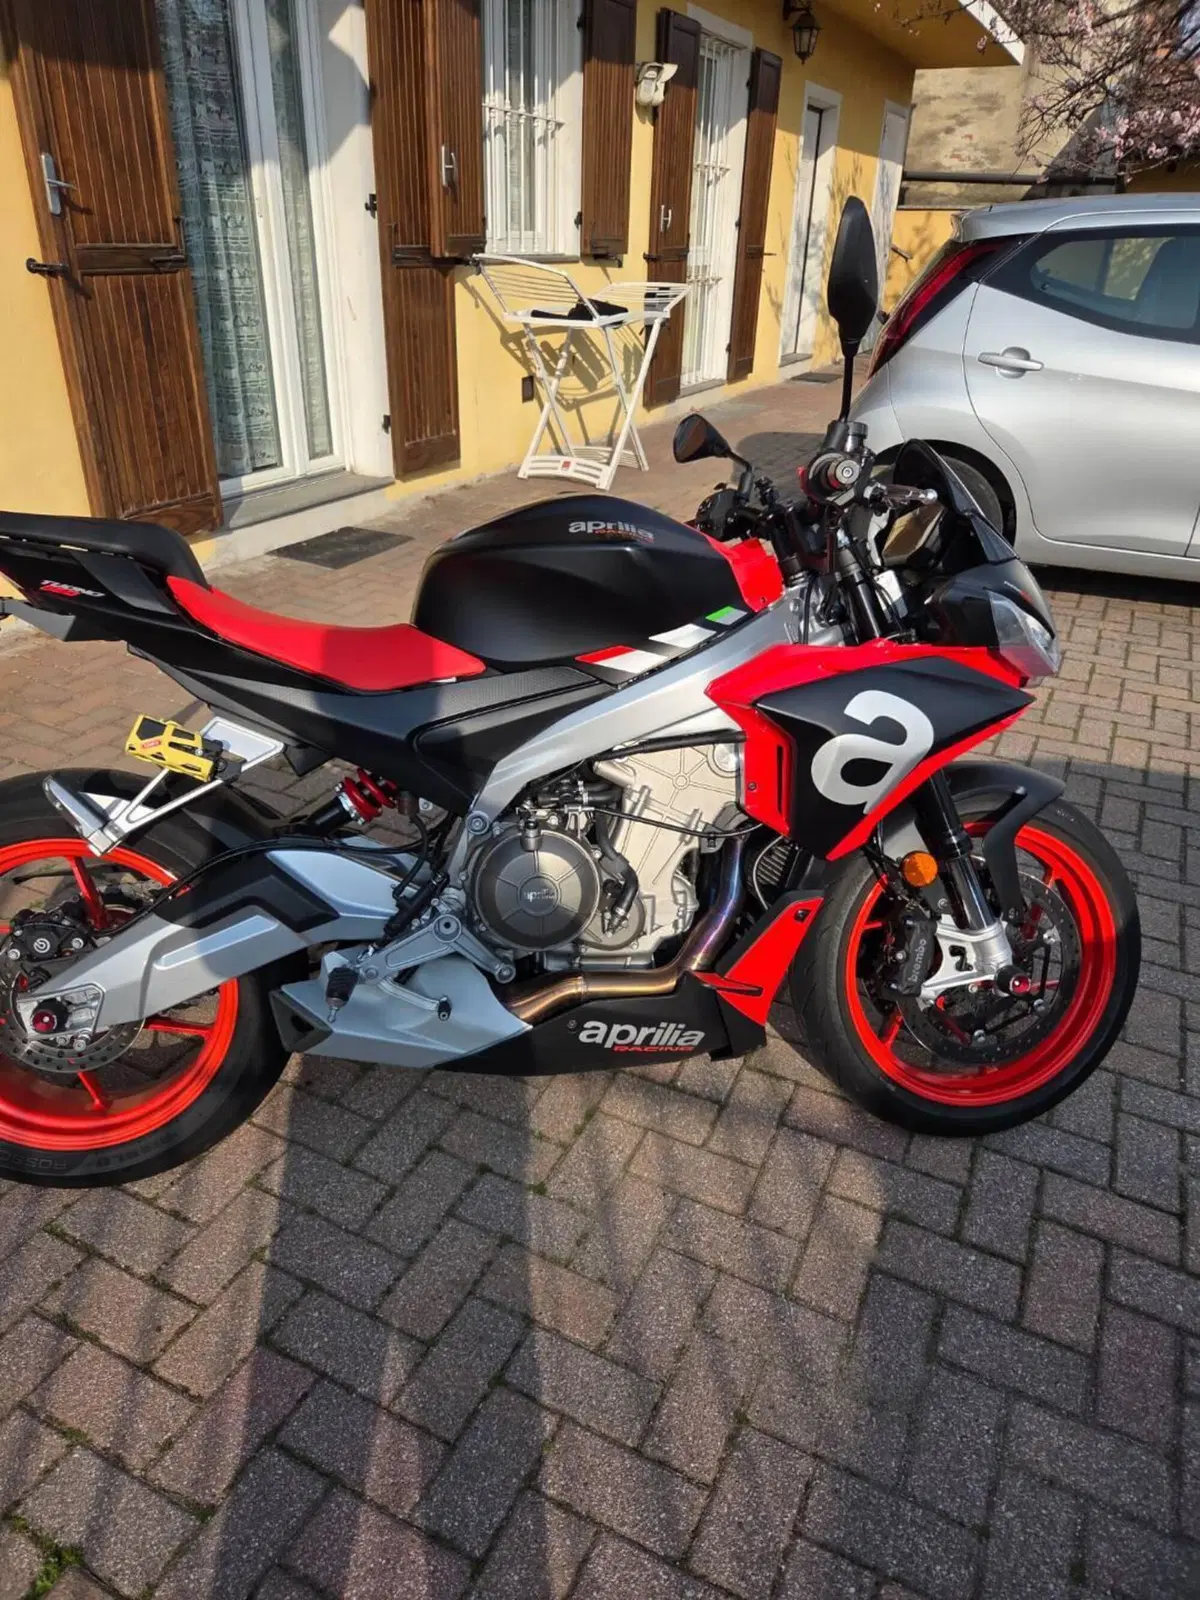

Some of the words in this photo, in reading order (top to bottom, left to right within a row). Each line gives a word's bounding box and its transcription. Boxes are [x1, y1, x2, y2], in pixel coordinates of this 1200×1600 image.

[568, 520, 654, 539] aprilia
[811, 690, 934, 815] a
[907, 938, 927, 982] brembo
[578, 1020, 706, 1049] aprilia
[613, 1045, 695, 1053] RACING
